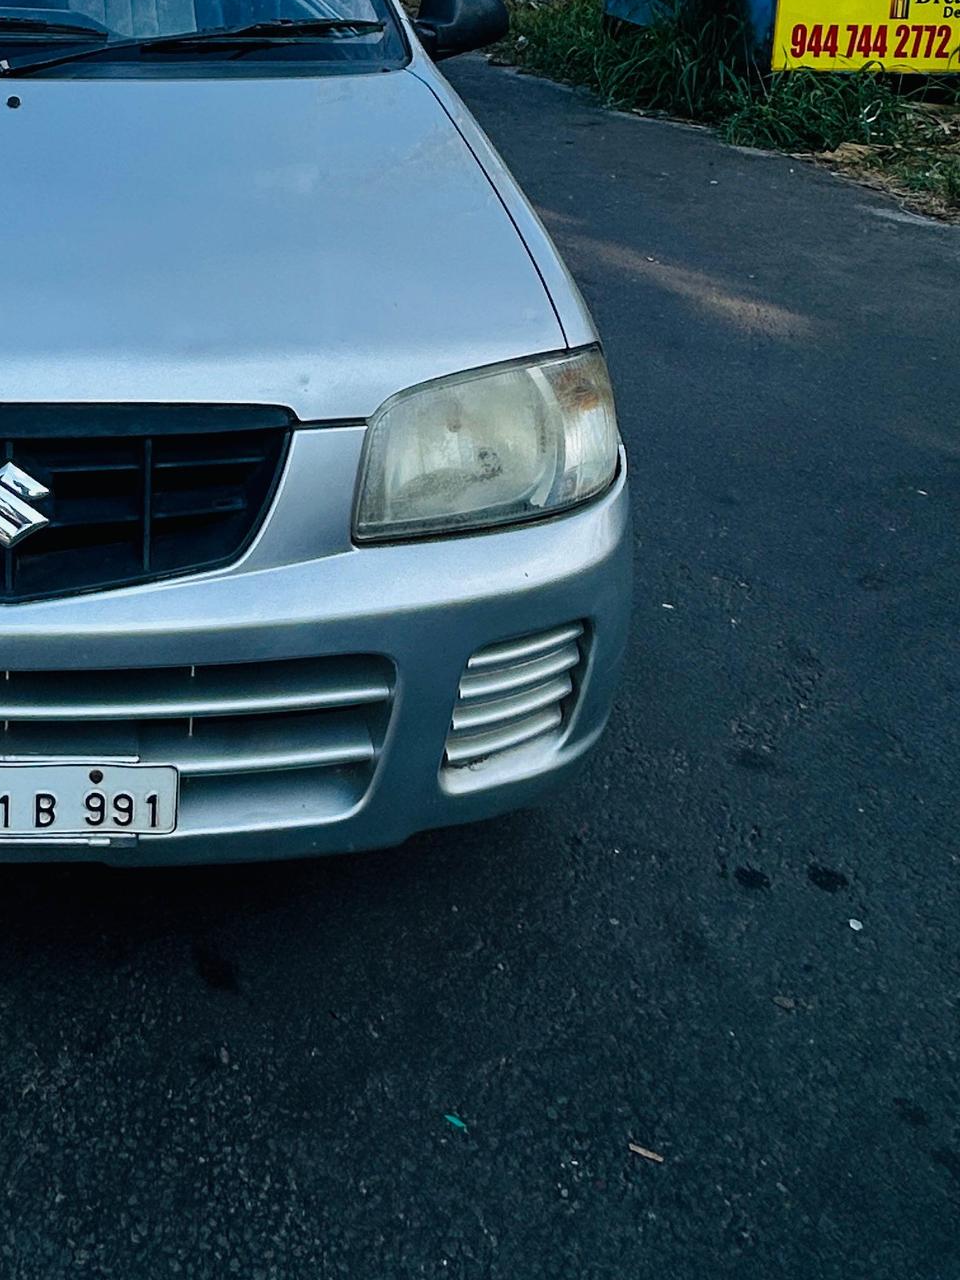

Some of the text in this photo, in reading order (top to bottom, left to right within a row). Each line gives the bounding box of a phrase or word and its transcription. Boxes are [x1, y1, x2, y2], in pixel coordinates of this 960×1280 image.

[790, 23, 952, 58] 944 744 2772
[35, 793, 57, 828] B
[84, 792, 159, 828] 991
